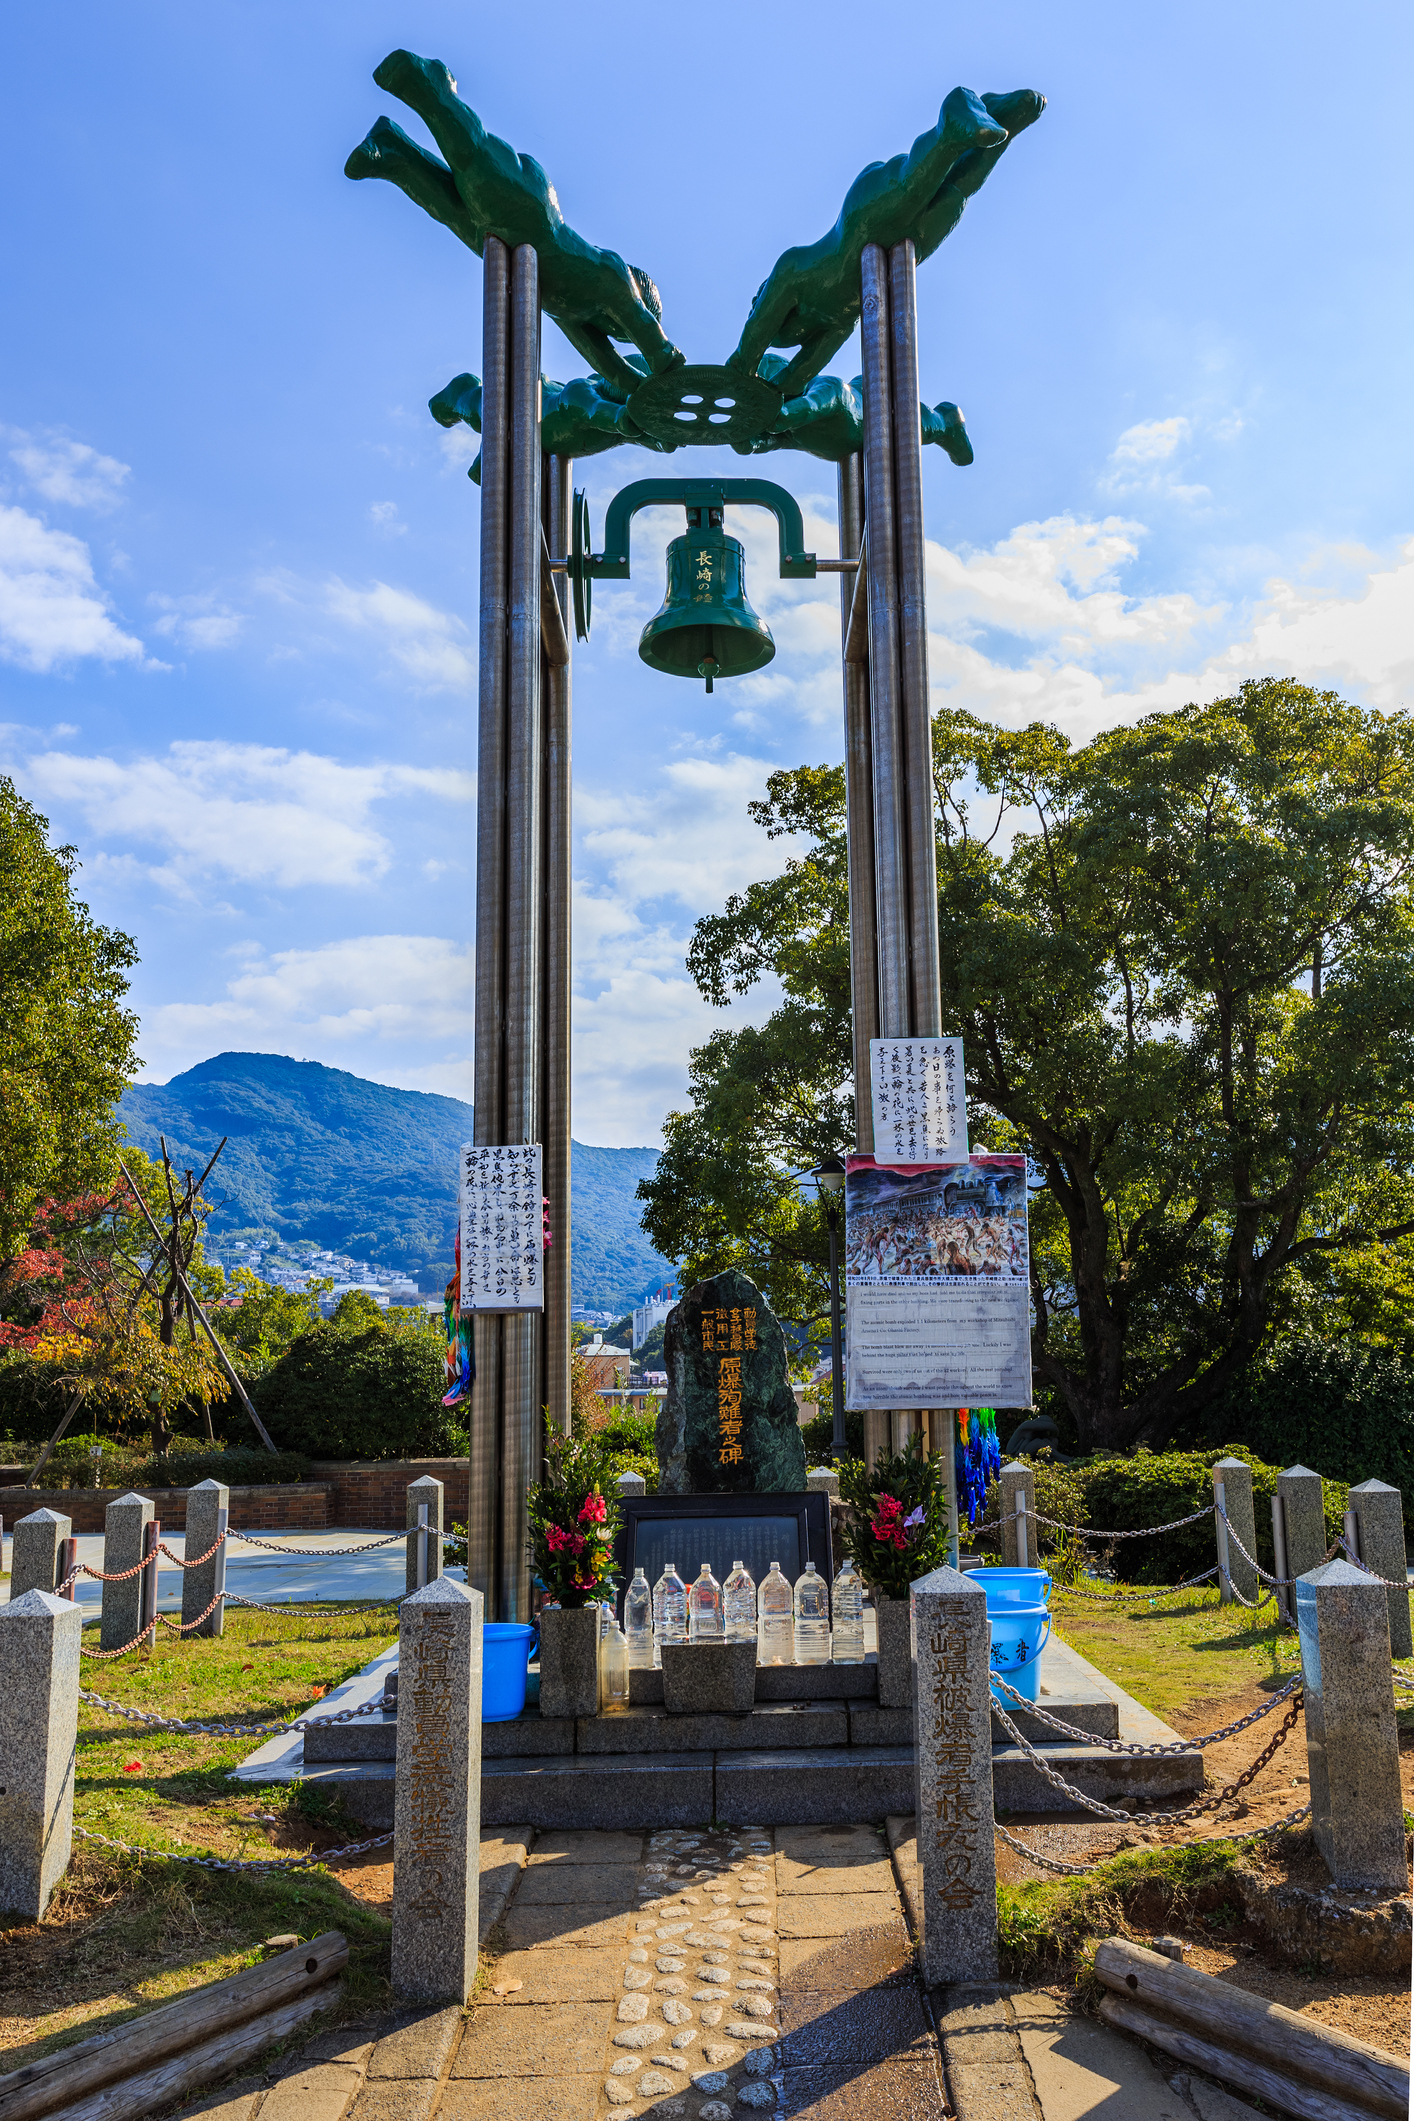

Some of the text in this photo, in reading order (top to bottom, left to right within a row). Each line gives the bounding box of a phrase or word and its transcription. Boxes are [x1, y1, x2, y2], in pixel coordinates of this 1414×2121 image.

[692, 550, 713, 603] 長崎の鐘
[701, 1310, 716, 1352] 一般市民
[717, 1357, 745, 1465] 原爆殉難者之碑
[408, 1611, 457, 1920] 長崎県動員学徒犠牲者の会
[930, 1600, 982, 1911] 長崎県被爆者手帳友の会
